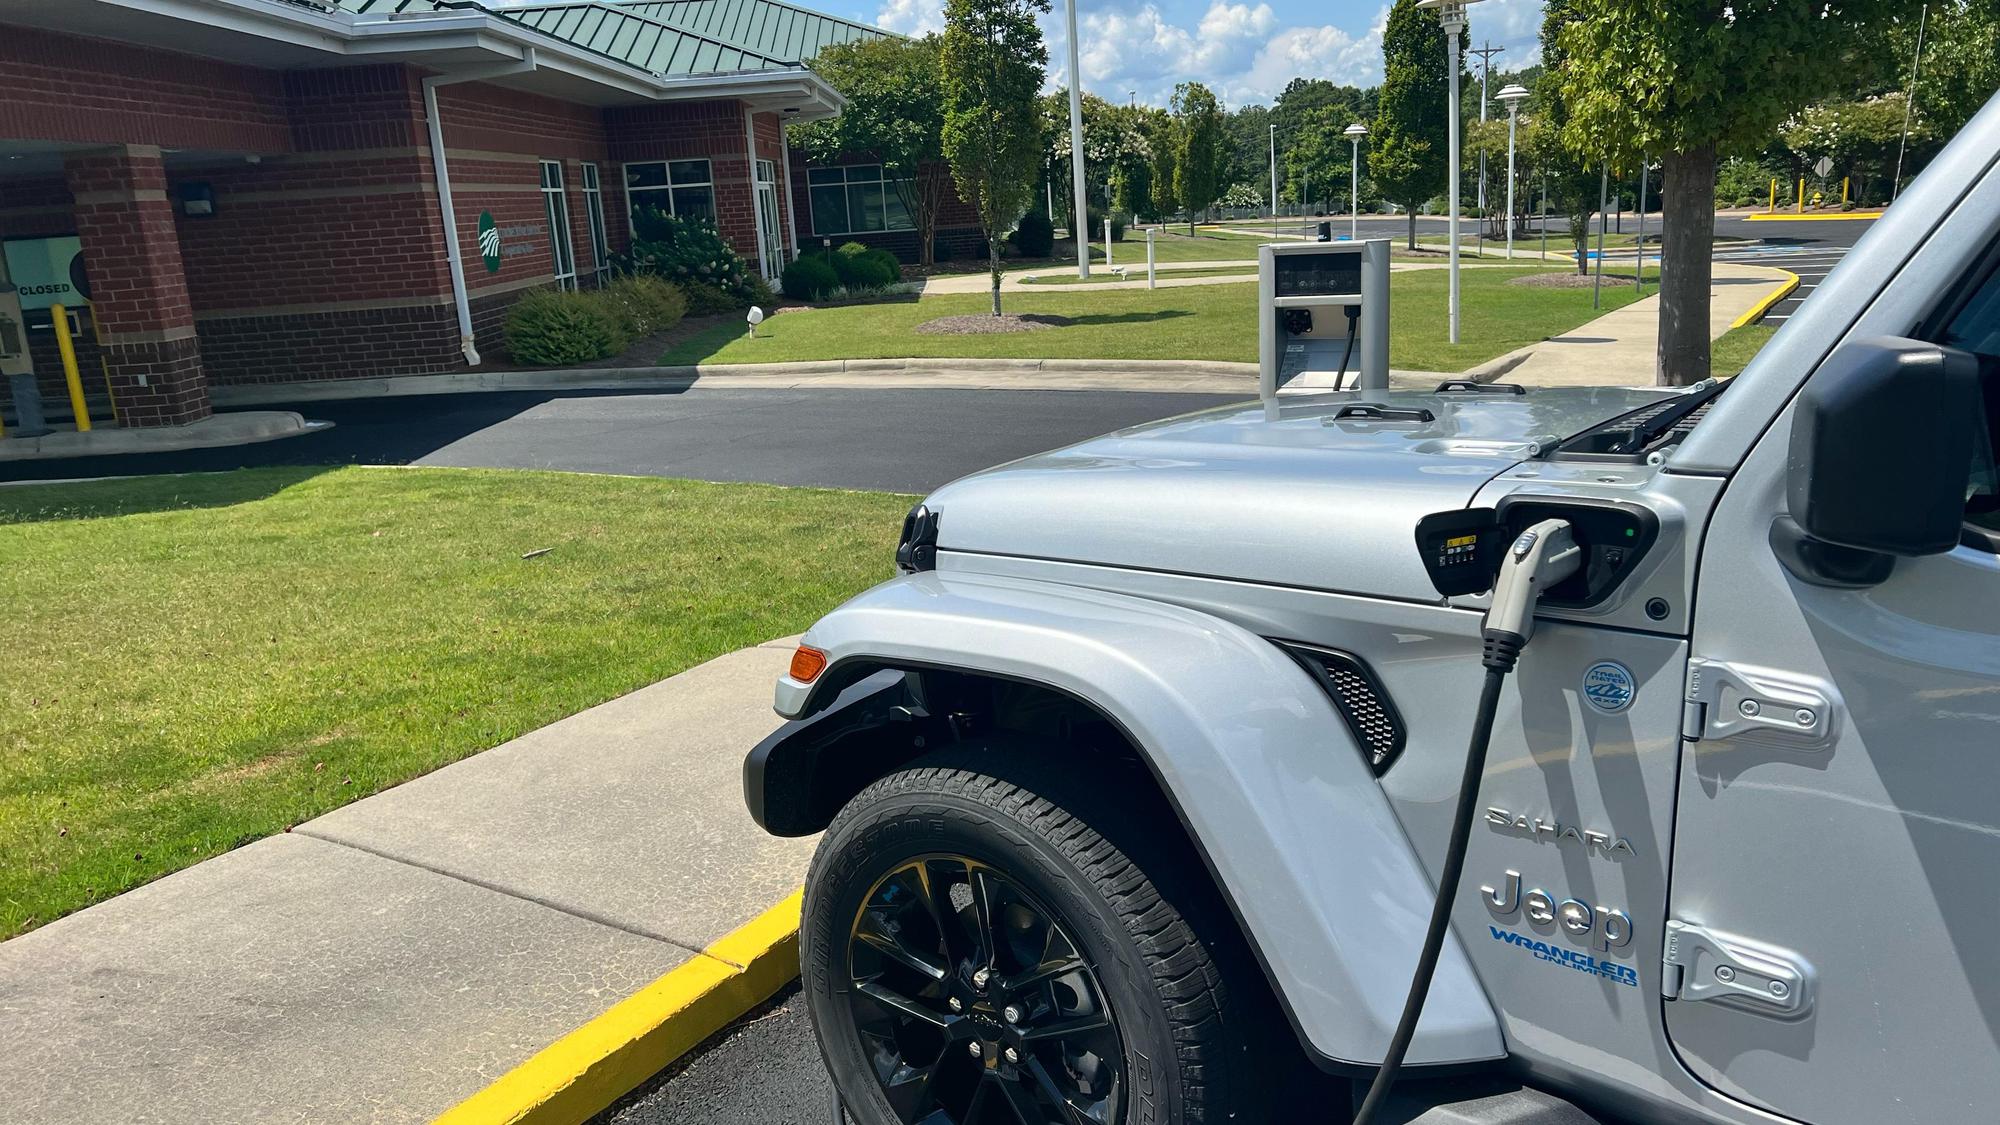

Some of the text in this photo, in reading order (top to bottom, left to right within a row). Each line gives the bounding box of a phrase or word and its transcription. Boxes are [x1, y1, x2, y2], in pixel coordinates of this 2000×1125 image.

[20, 283, 70, 296] CLOSED
[1484, 807, 1637, 857] SAHARA
[1480, 869, 1633, 952] Jeep
[1488, 925, 1637, 981] WRANGLER
[1533, 951, 1638, 987] UNLIMITED
